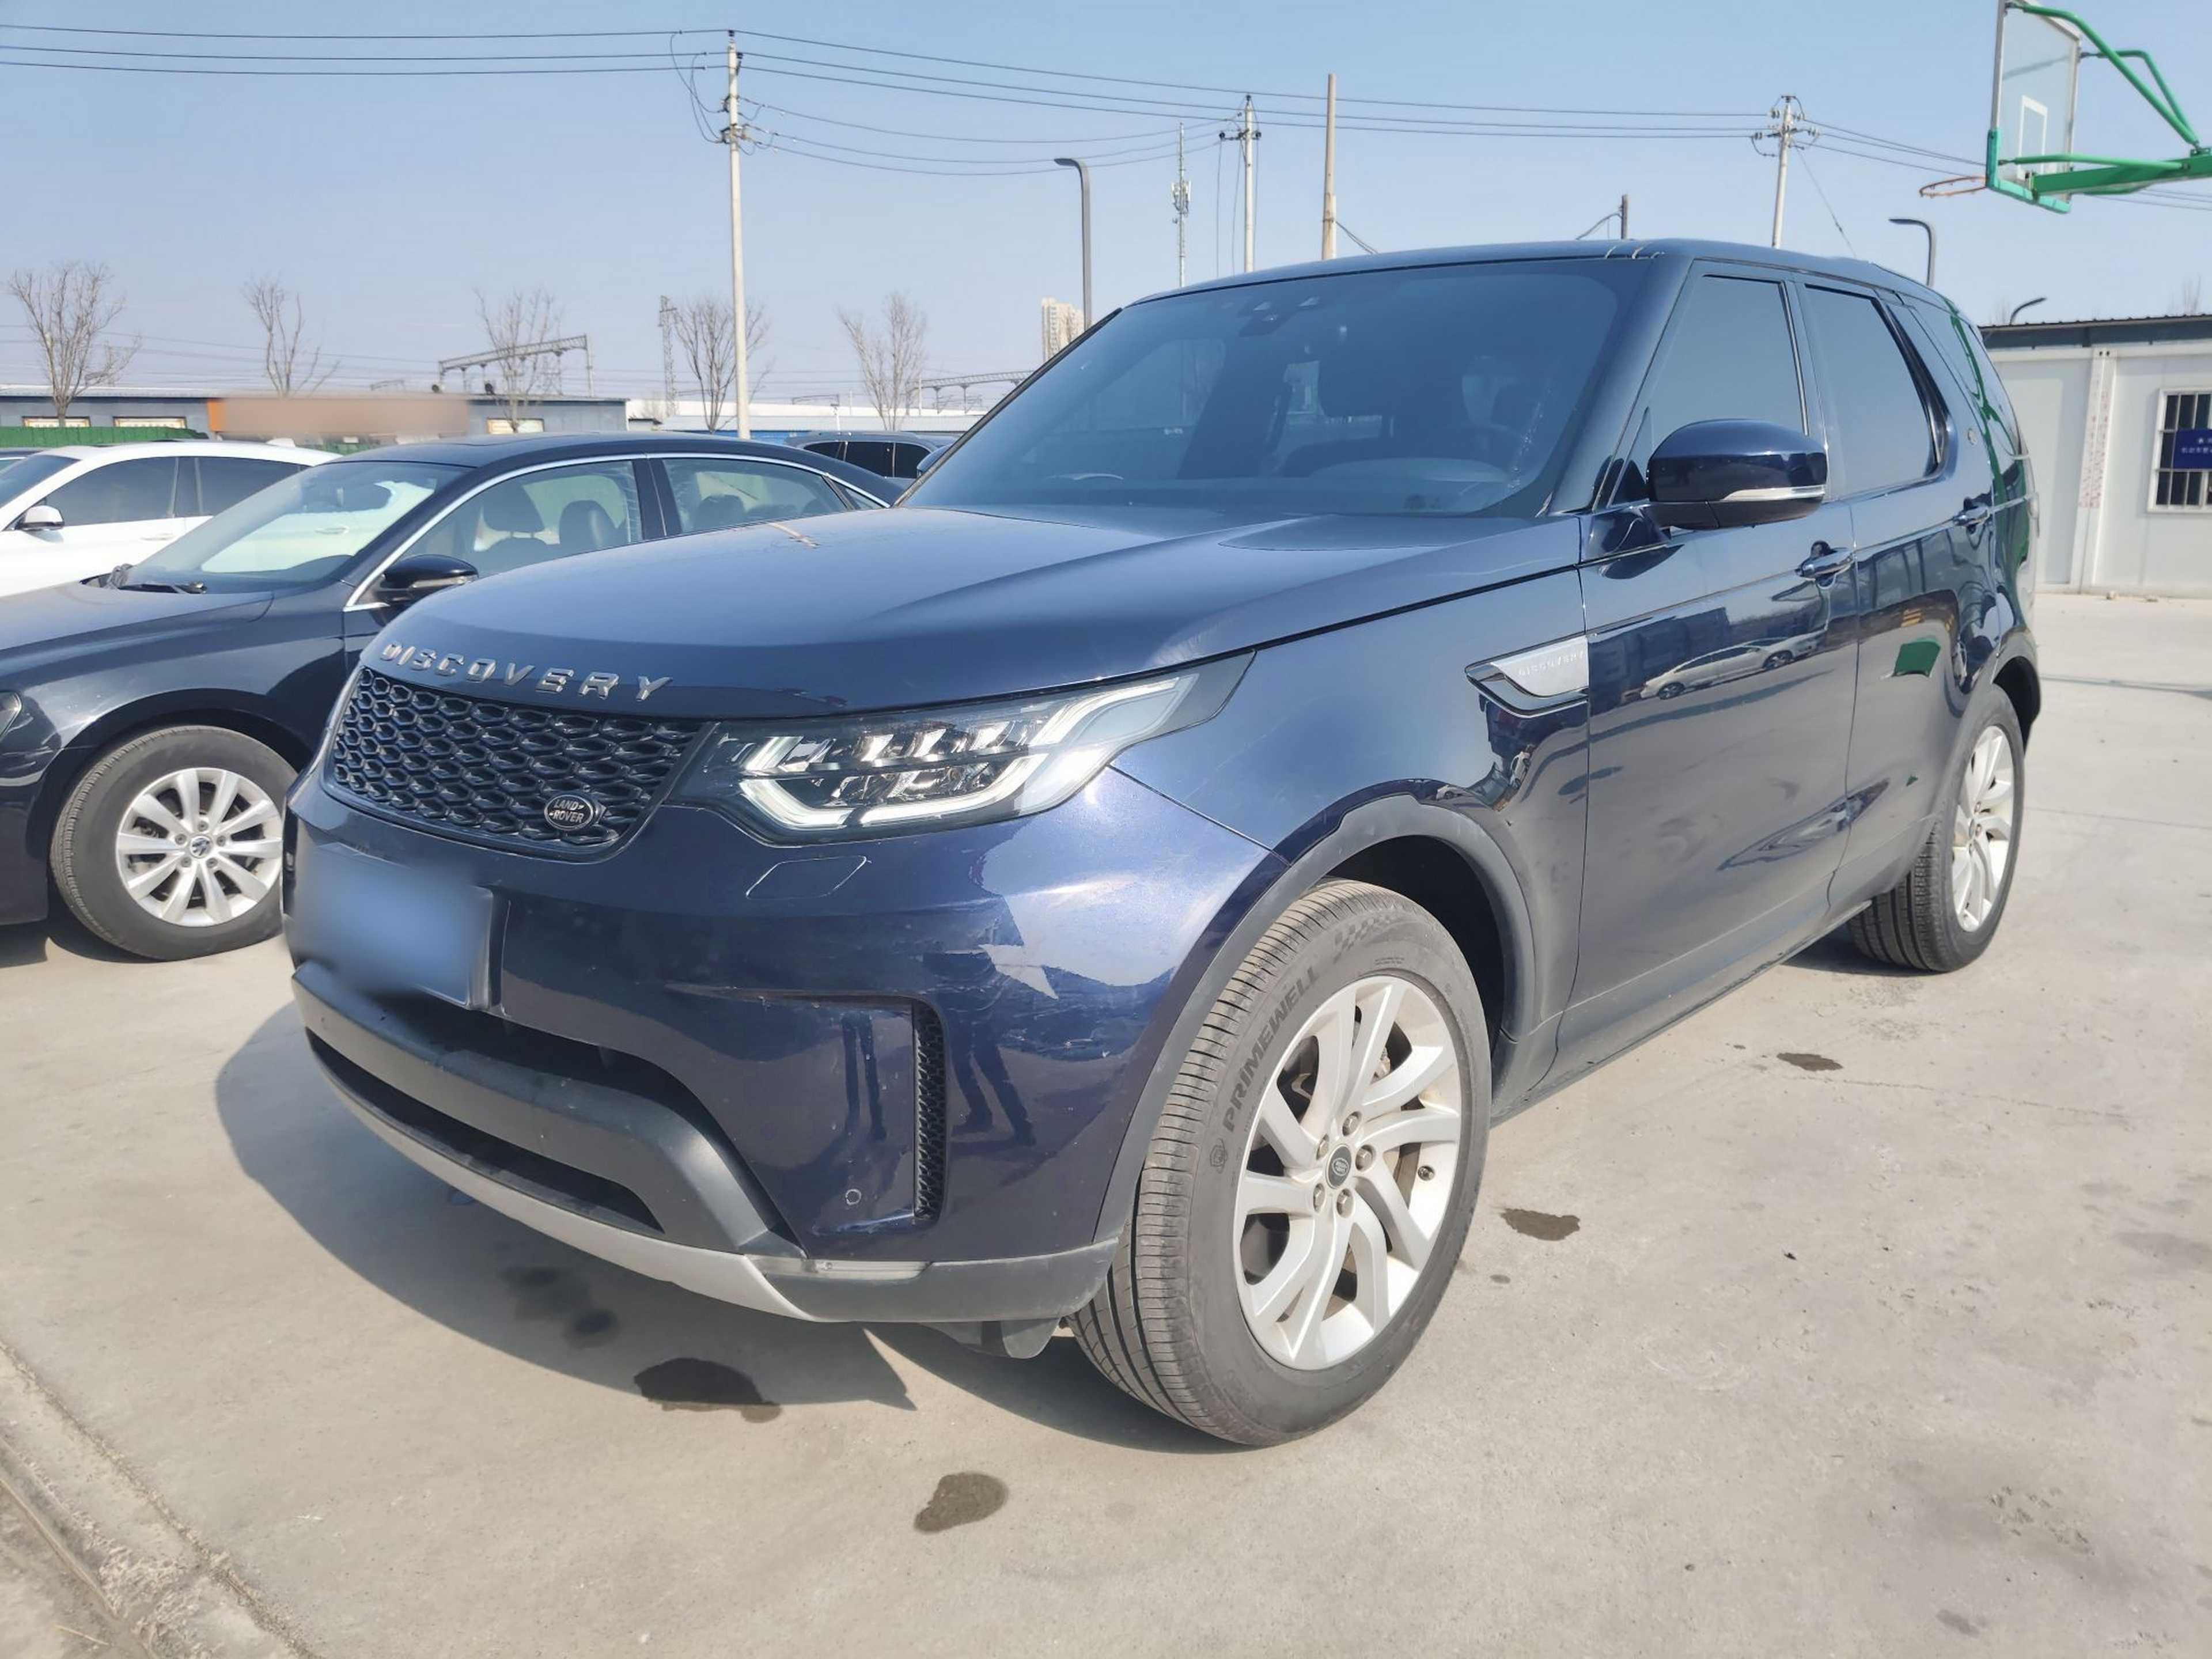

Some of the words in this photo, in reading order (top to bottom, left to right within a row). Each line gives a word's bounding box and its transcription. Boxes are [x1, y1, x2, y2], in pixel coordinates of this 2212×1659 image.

[381, 643, 673, 700] DISCOVERY
[552, 809, 584, 823] ROVER
[554, 799, 579, 810] LAND
[1222, 967, 1320, 1132] PRIMEWELL
